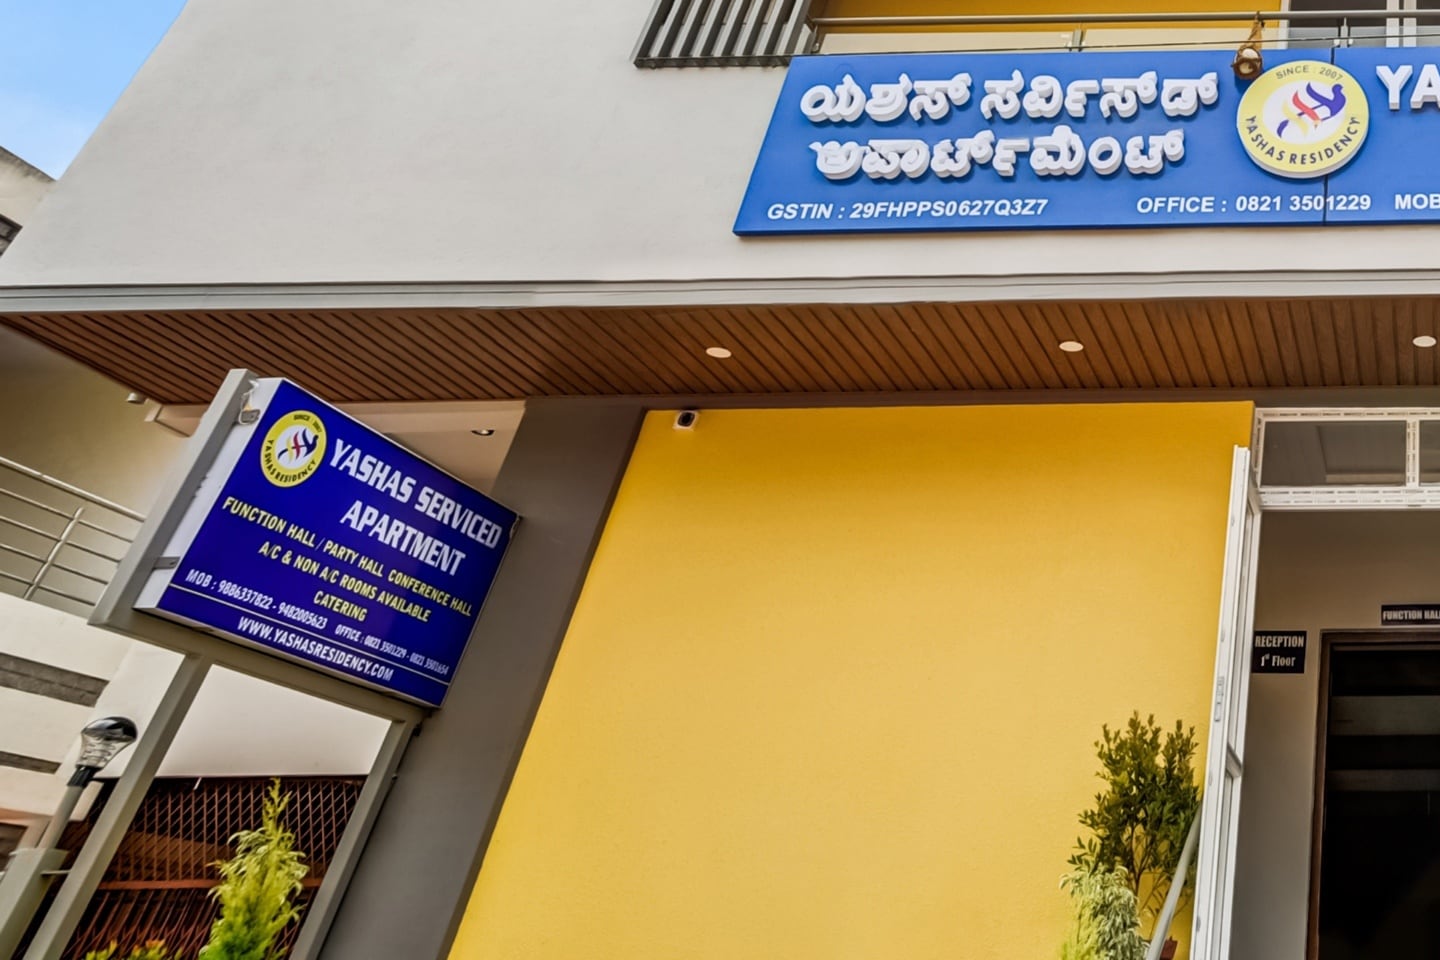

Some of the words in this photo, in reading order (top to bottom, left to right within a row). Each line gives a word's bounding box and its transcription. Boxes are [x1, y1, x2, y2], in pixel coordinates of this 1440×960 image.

[800, 72, 973, 122] ಯಶಸ್
[1276, 65, 1309, 79] SINCE
[1319, 67, 1344, 81] 2007
[1246, 116, 1286, 161] YASHAS
[1289, 117, 1361, 165] RESIDENCY
[767, 203, 833, 220] GSTIN
[849, 199, 1048, 219] 29FHPPS0627Q3Z7
[1136, 196, 1215, 214] OFFICE
[1235, 196, 1282, 212] 0821
[1289, 194, 1371, 211] 3501229
[330, 438, 416, 503] YASHAS
[414, 486, 502, 549] SERVICED
[222, 496, 287, 533] FUNCTION
[286, 523, 316, 548] HALL
[323, 540, 359, 564] PARTY
[358, 556, 384, 578] HALL
[388, 569, 452, 606] CONFERENCE
[450, 597, 473, 617] HALL
[340, 500, 466, 576] APARTMENT
[185, 568, 213, 587] MOB
[217, 580, 274, 610] 9886337822
[335, 624, 361, 642] OFFICE
[258, 541, 281, 560] A/C
[281, 550, 293, 565] &
[293, 554, 320, 575] NON
[319, 566, 339, 584] A/C
[340, 574, 378, 599] ROOMS
[377, 590, 431, 622] AVAILABLE
[314, 590, 368, 621] CATERING
[1382, 610, 1422, 620] FUNCTION
[237, 616, 394, 681] WWW.YASHASRESIDENCY.COM
[1255, 635, 1304, 648] RECEPTION
[1272, 655, 1296, 667] Floor
